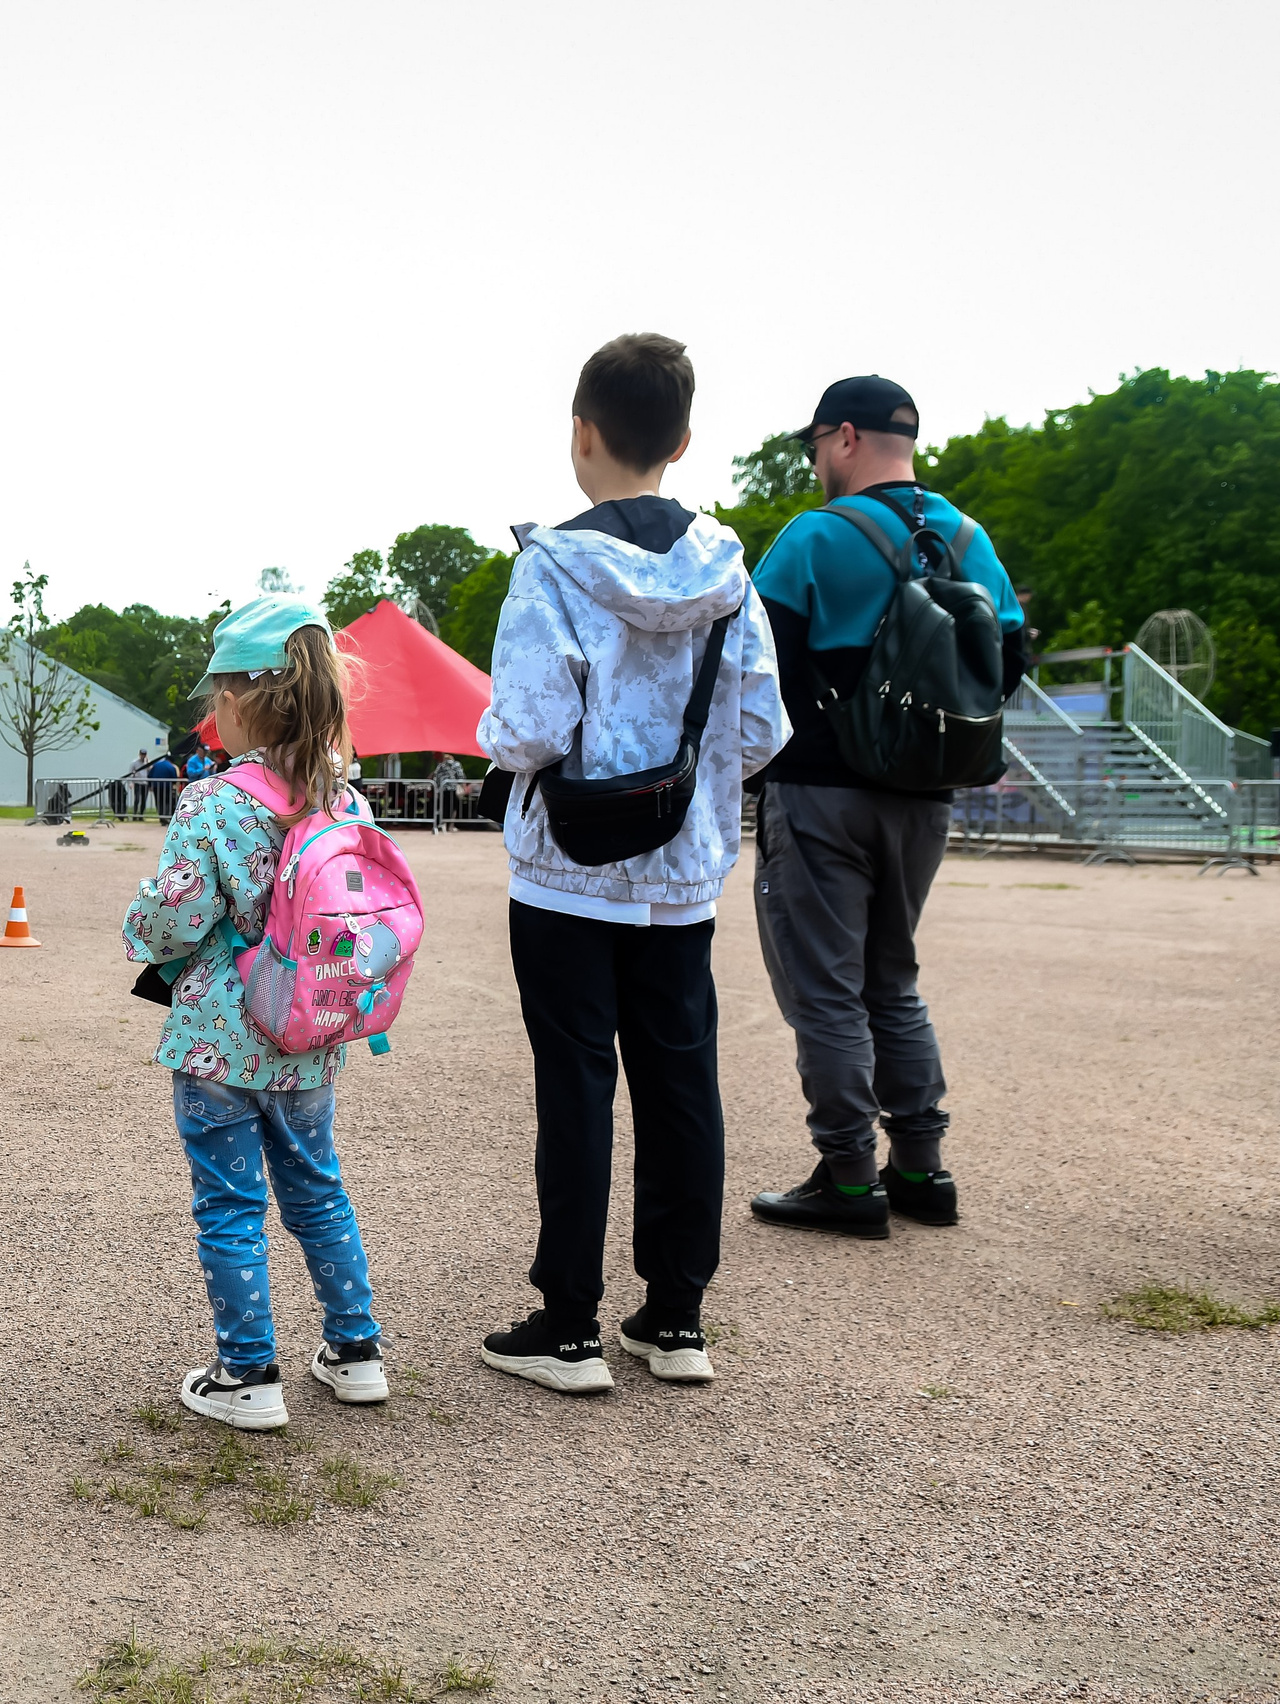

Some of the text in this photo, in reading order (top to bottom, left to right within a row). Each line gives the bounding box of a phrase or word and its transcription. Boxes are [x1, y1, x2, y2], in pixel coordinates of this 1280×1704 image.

[315, 958, 356, 981] DANCE
[311, 989, 357, 1007] AND BE
[314, 1010, 350, 1028] HAPPY
[679, 1330, 698, 1339] FILA
[559, 1339, 600, 1353] FILA FILA
